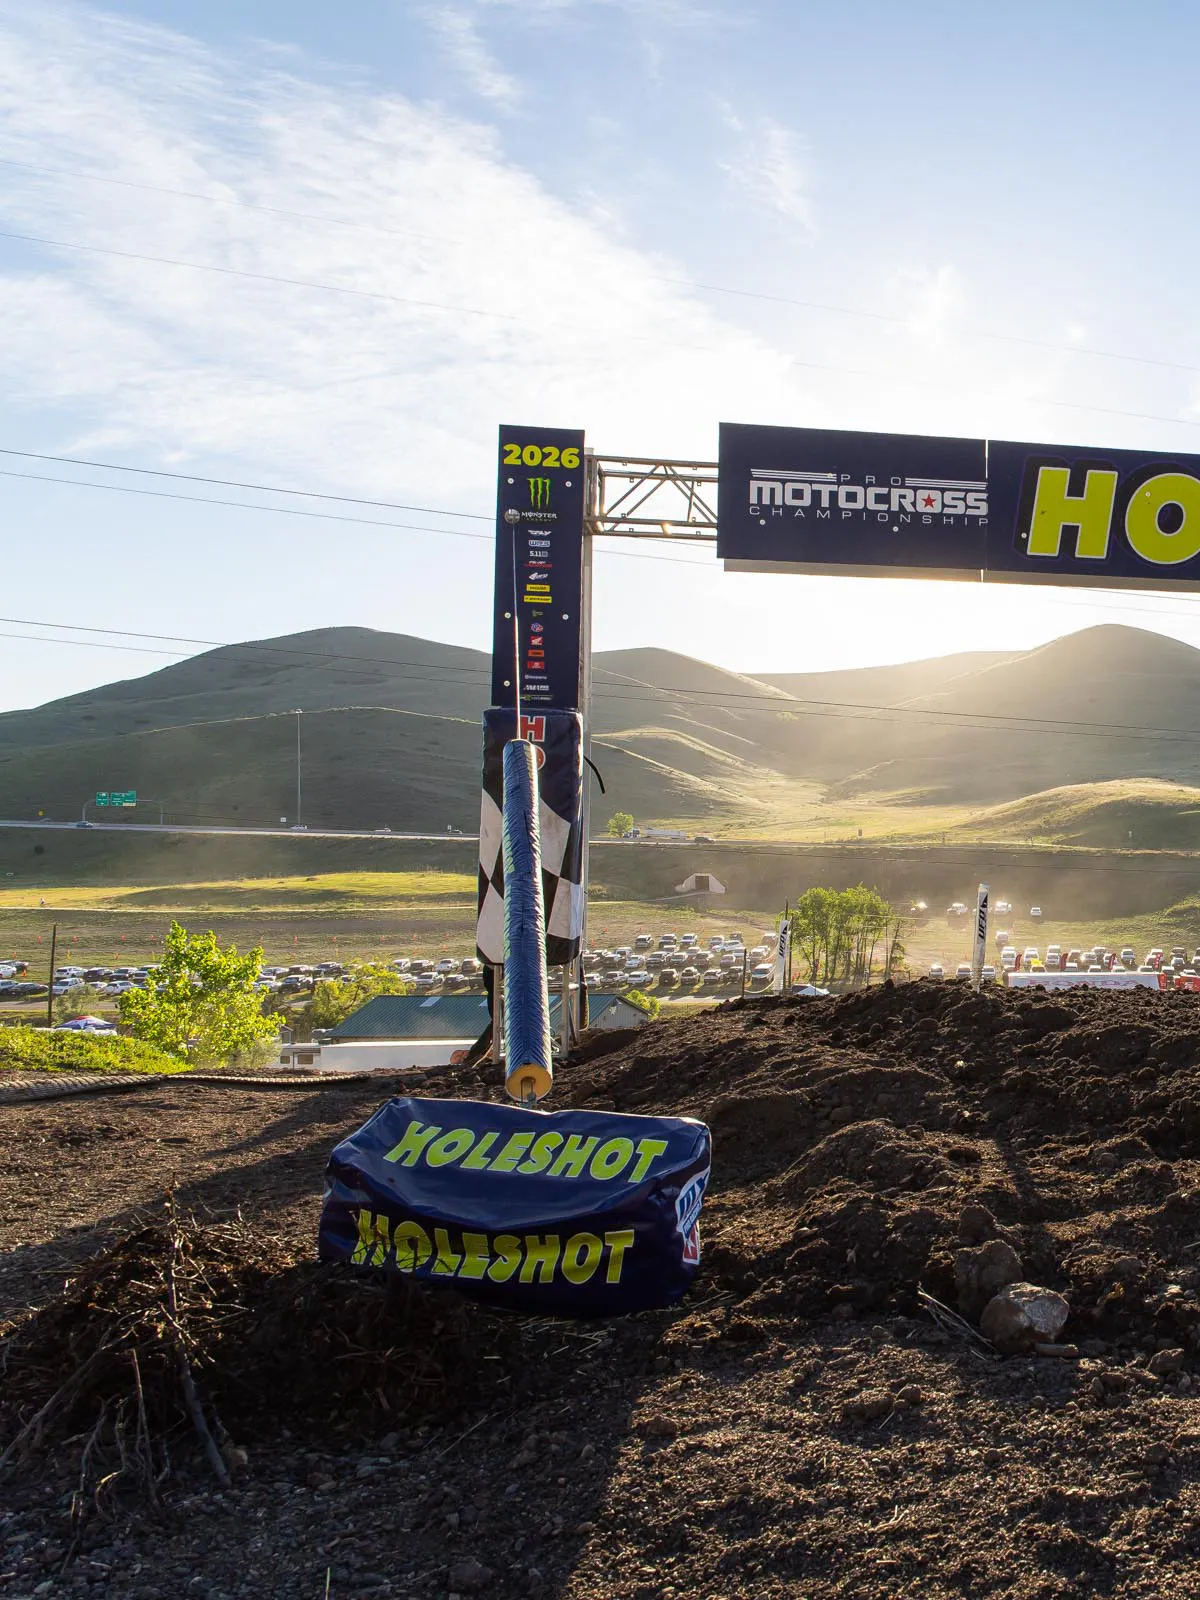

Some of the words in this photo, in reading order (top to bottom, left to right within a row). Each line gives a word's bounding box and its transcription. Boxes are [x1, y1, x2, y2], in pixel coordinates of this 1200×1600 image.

[503, 444, 580, 468] 2026
[840, 474, 902, 486] PRO
[749, 480, 989, 515] MOTOCROSS
[749, 506, 989, 526] CHAMPIONSHIP
[384, 1120, 668, 1183] HOLESHOT
[350, 1208, 635, 1284] HOLESHOT
